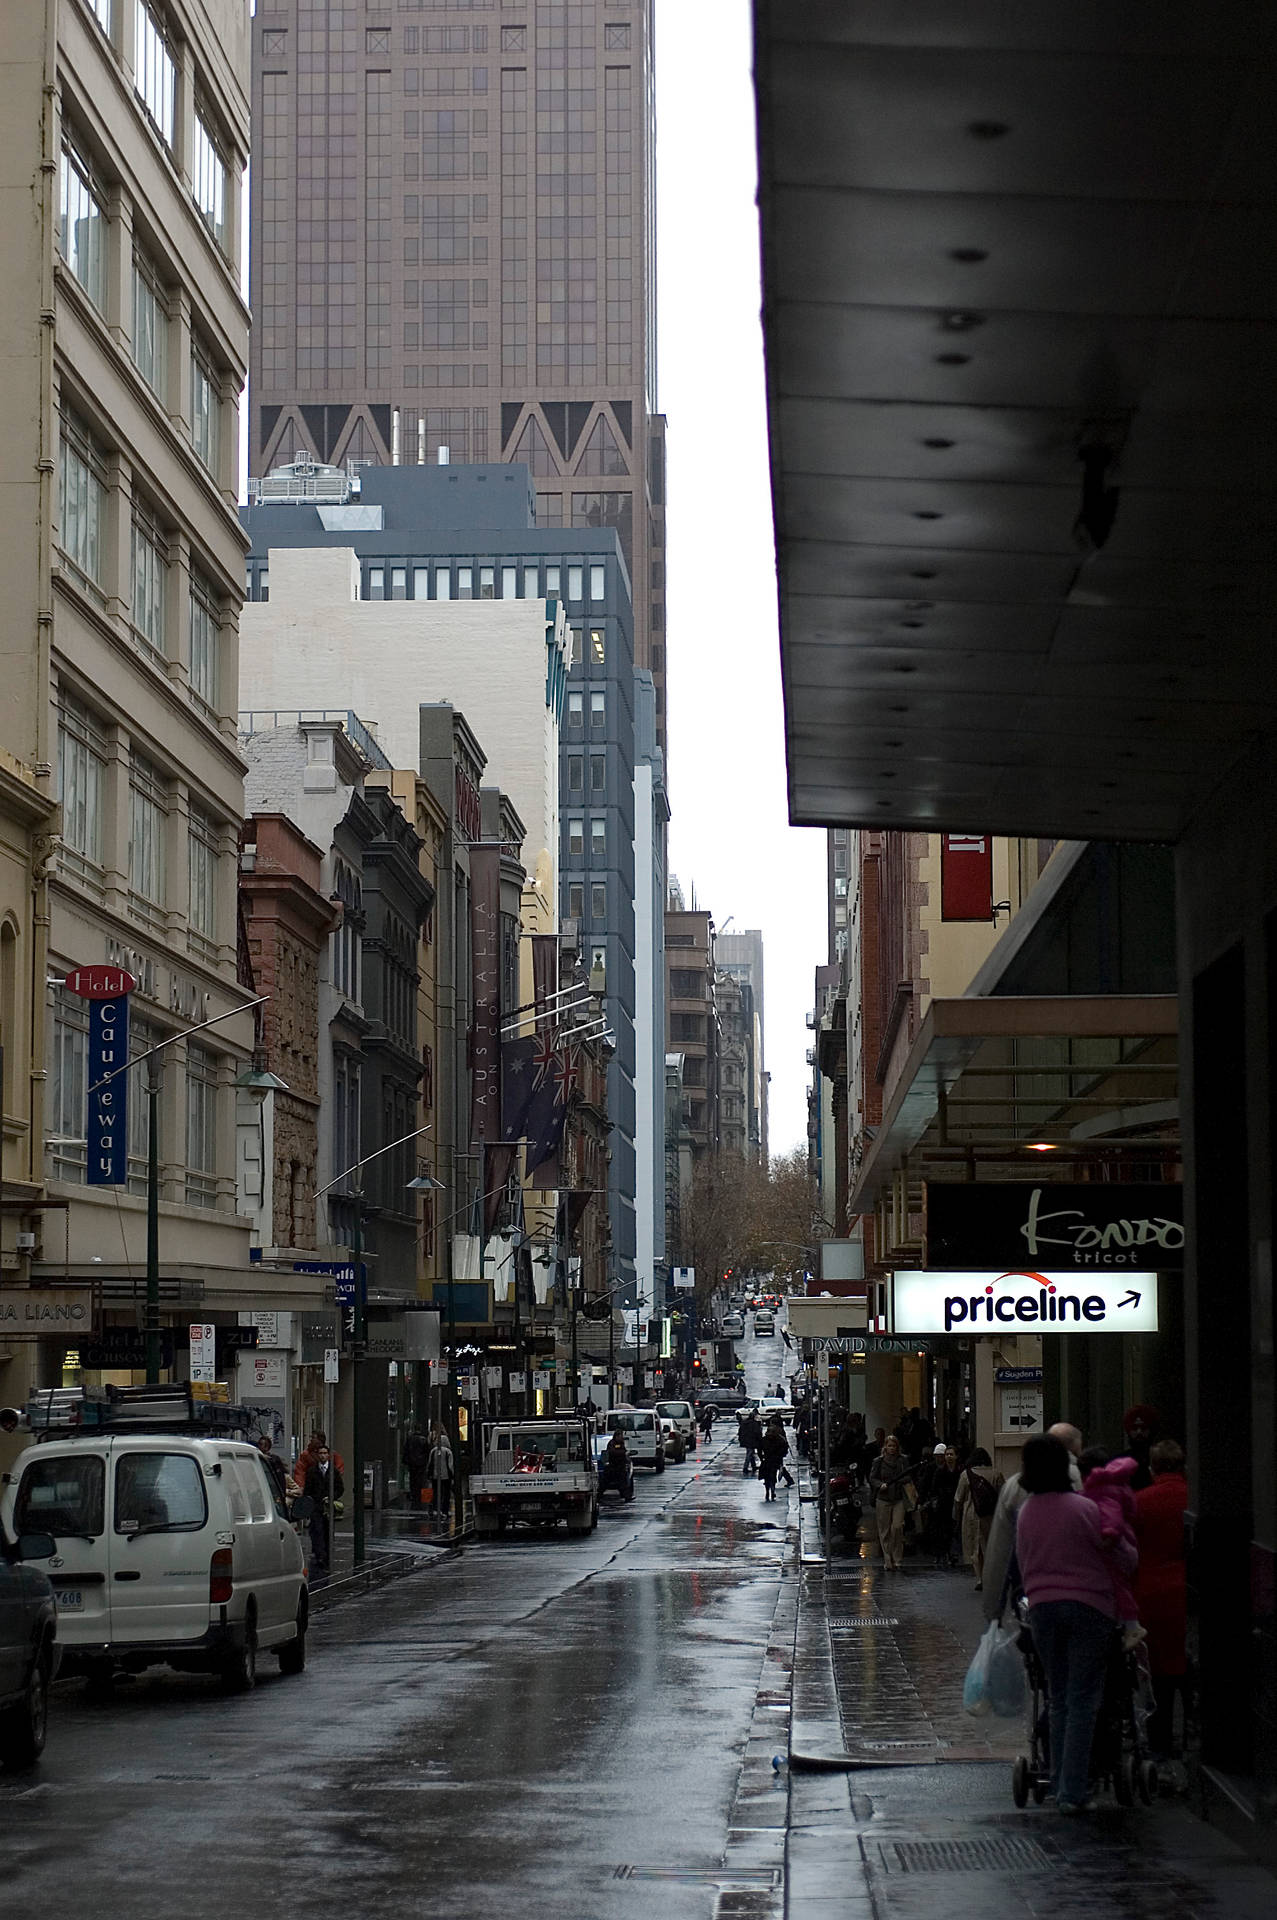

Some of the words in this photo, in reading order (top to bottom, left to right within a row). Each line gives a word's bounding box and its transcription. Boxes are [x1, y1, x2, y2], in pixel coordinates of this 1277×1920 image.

[75, 972, 125, 991] Hotel
[487, 912, 498, 1037] COLLINS
[474, 902, 489, 1105] AUSTRALIA
[488, 1064, 498, 1096] ON
[98, 1004, 118, 1177] Causeway
[1072, 1250, 1139, 1265] tricot
[26, 1303, 88, 1321] LIANO
[944, 1285, 1107, 1332] priceline
[810, 1337, 866, 1352] DAVID
[871, 1337, 930, 1352] JONES
[1004, 1369, 1034, 1380] Sugden
[62, 1592, 82, 1604] 608
